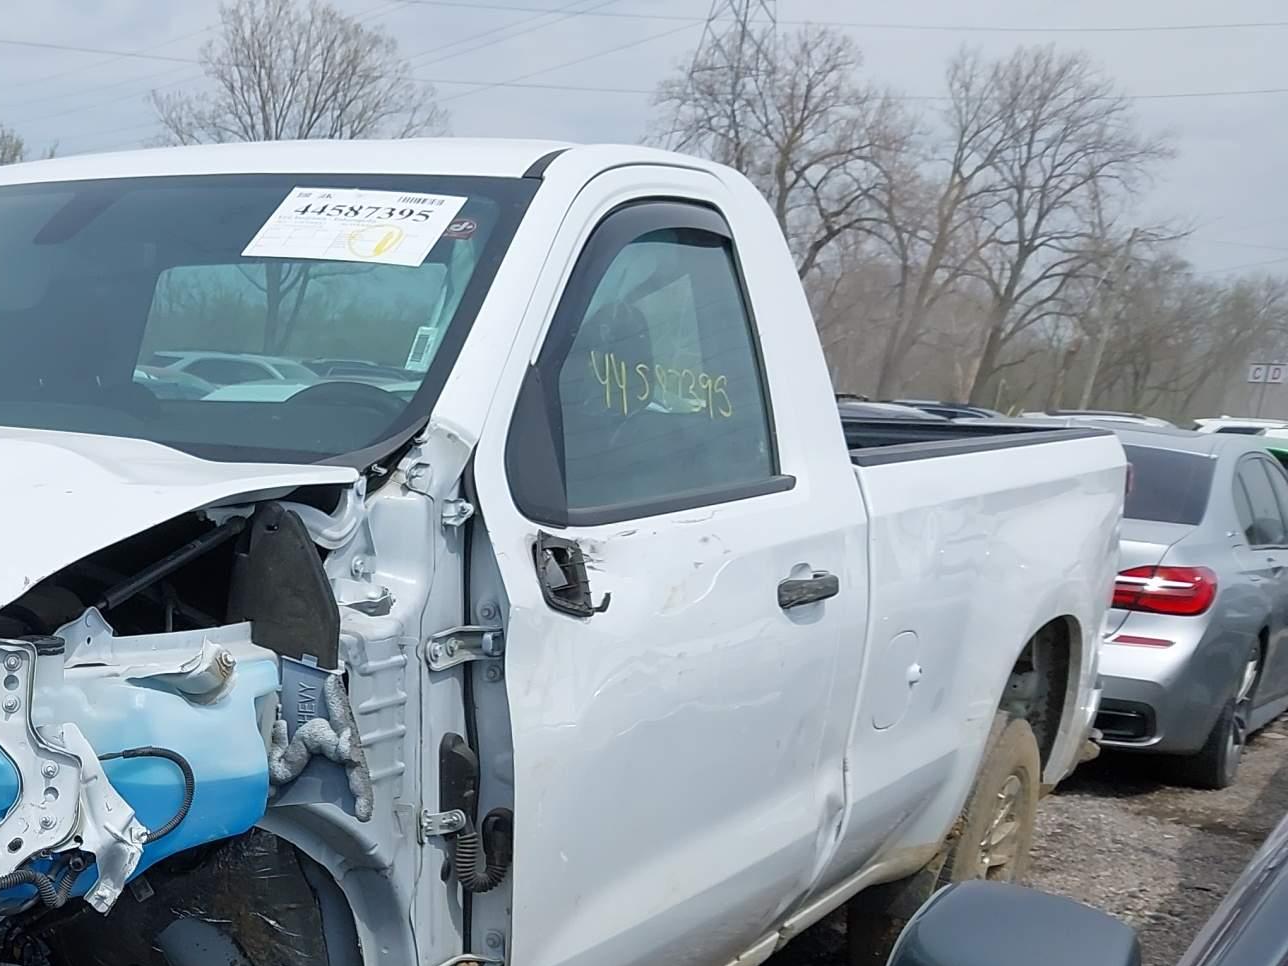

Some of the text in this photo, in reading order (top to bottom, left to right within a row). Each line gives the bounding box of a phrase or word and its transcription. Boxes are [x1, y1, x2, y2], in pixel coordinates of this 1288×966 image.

[294, 203, 434, 223] 44587395
[1252, 367, 1282, 380] C D
